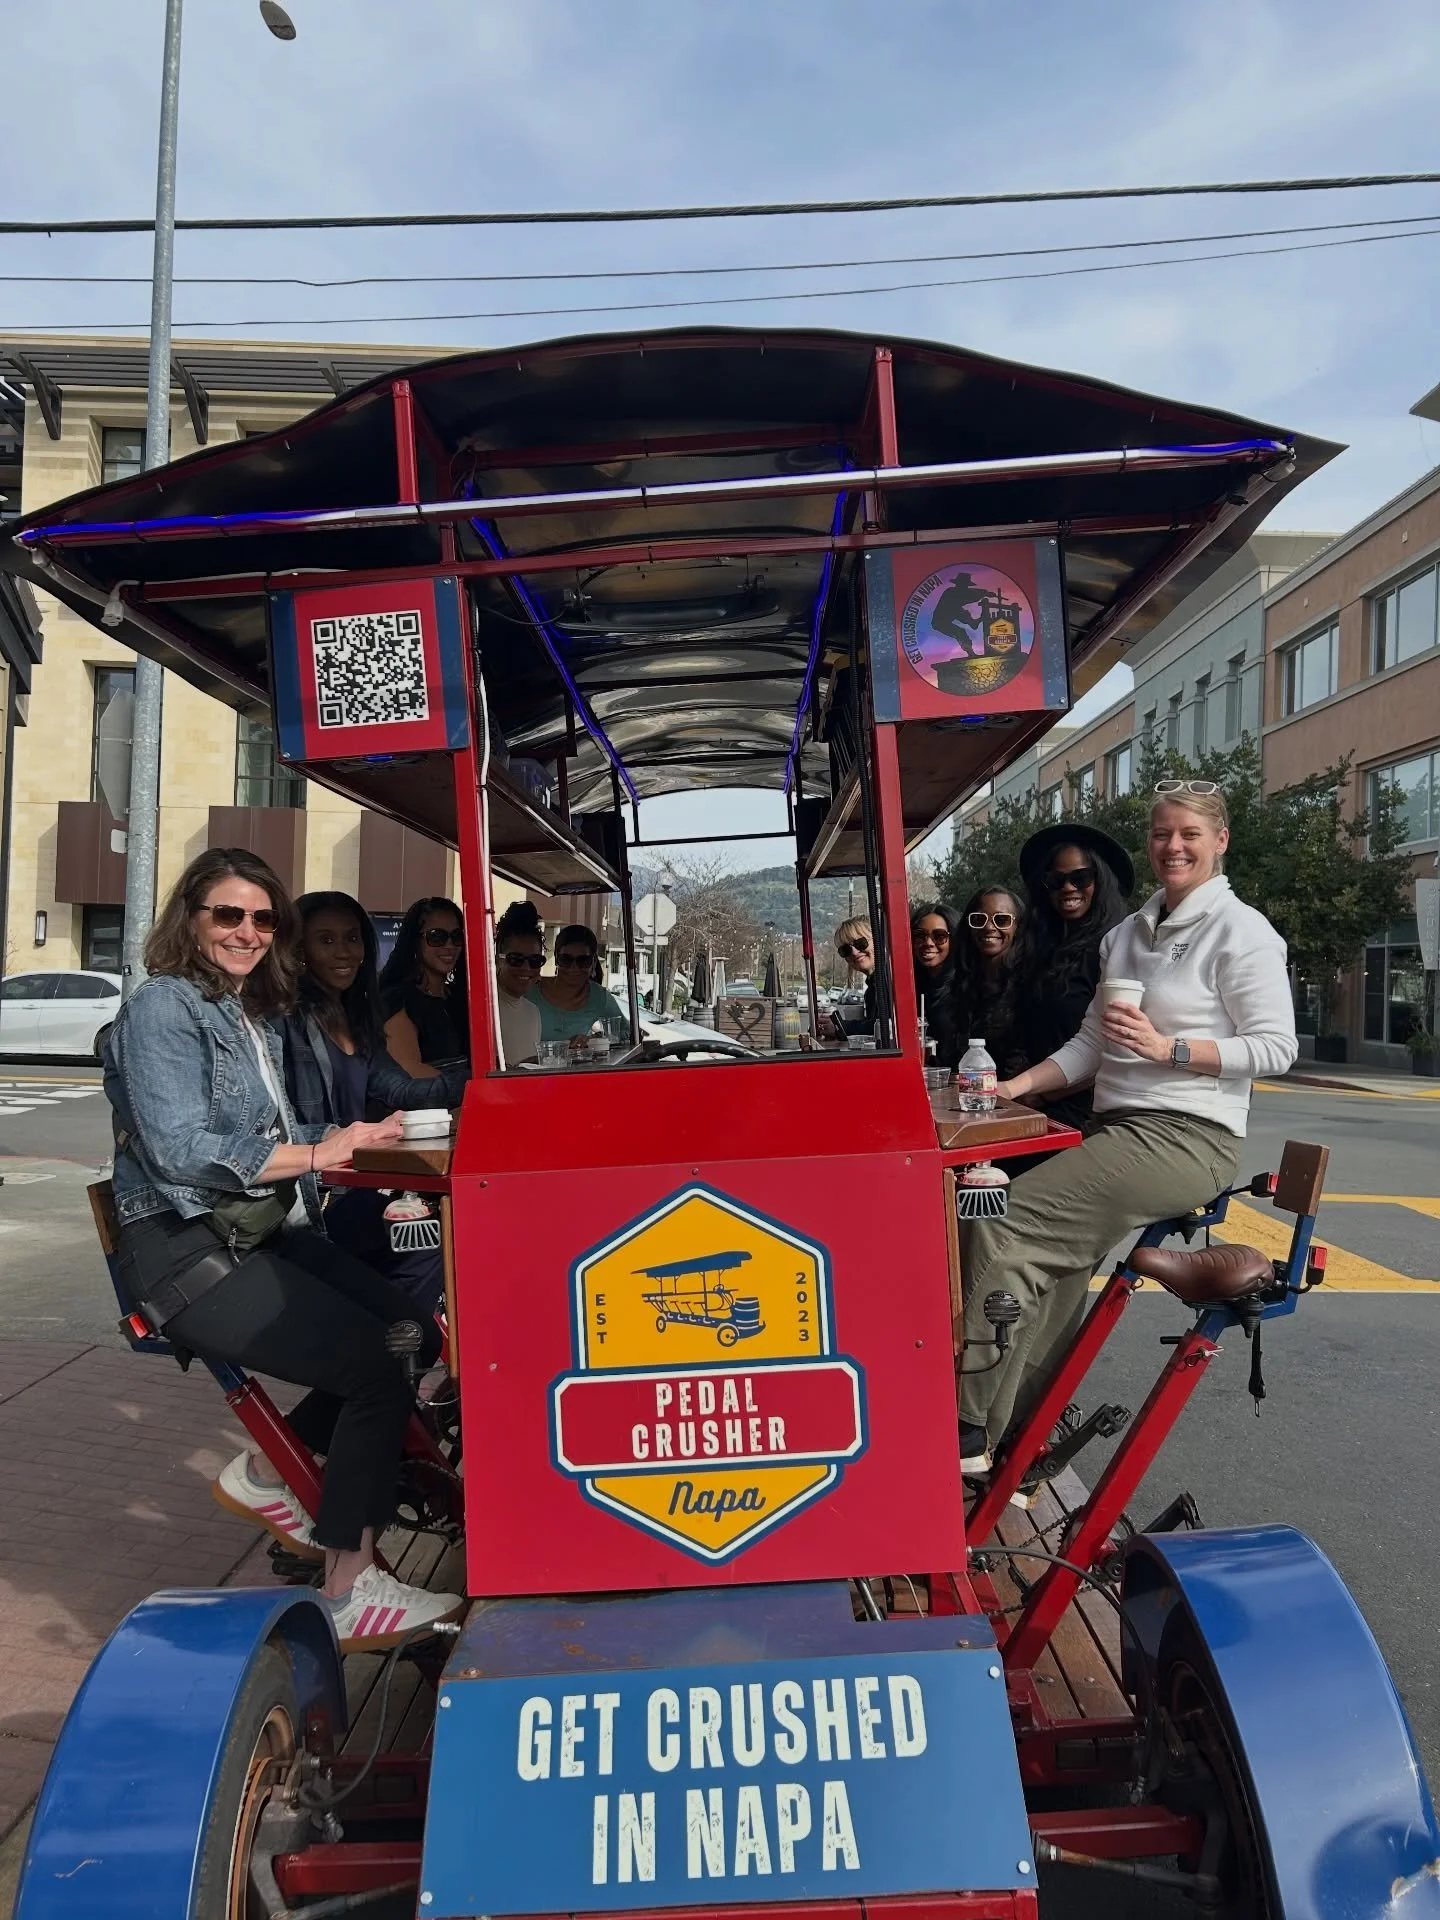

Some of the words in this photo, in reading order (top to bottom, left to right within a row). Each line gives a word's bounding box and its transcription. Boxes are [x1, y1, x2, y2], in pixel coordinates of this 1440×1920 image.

[911, 593, 925, 607] IN
[918, 573, 943, 598] NAPA
[903, 605, 919, 648] CRUSHED
[907, 648, 923, 665] GET
[595, 1293, 607, 1344] EST
[795, 1271, 810, 1342] 2023
[655, 1377, 759, 1418] PEDAL
[631, 1416, 787, 1459] CRUSHER
[668, 1480, 766, 1522] Napa
[517, 1692, 621, 1781] GET
[647, 1674, 928, 1773] CRUSHED
[592, 1791, 656, 1885] IN
[686, 1780, 861, 1879] NAPA
